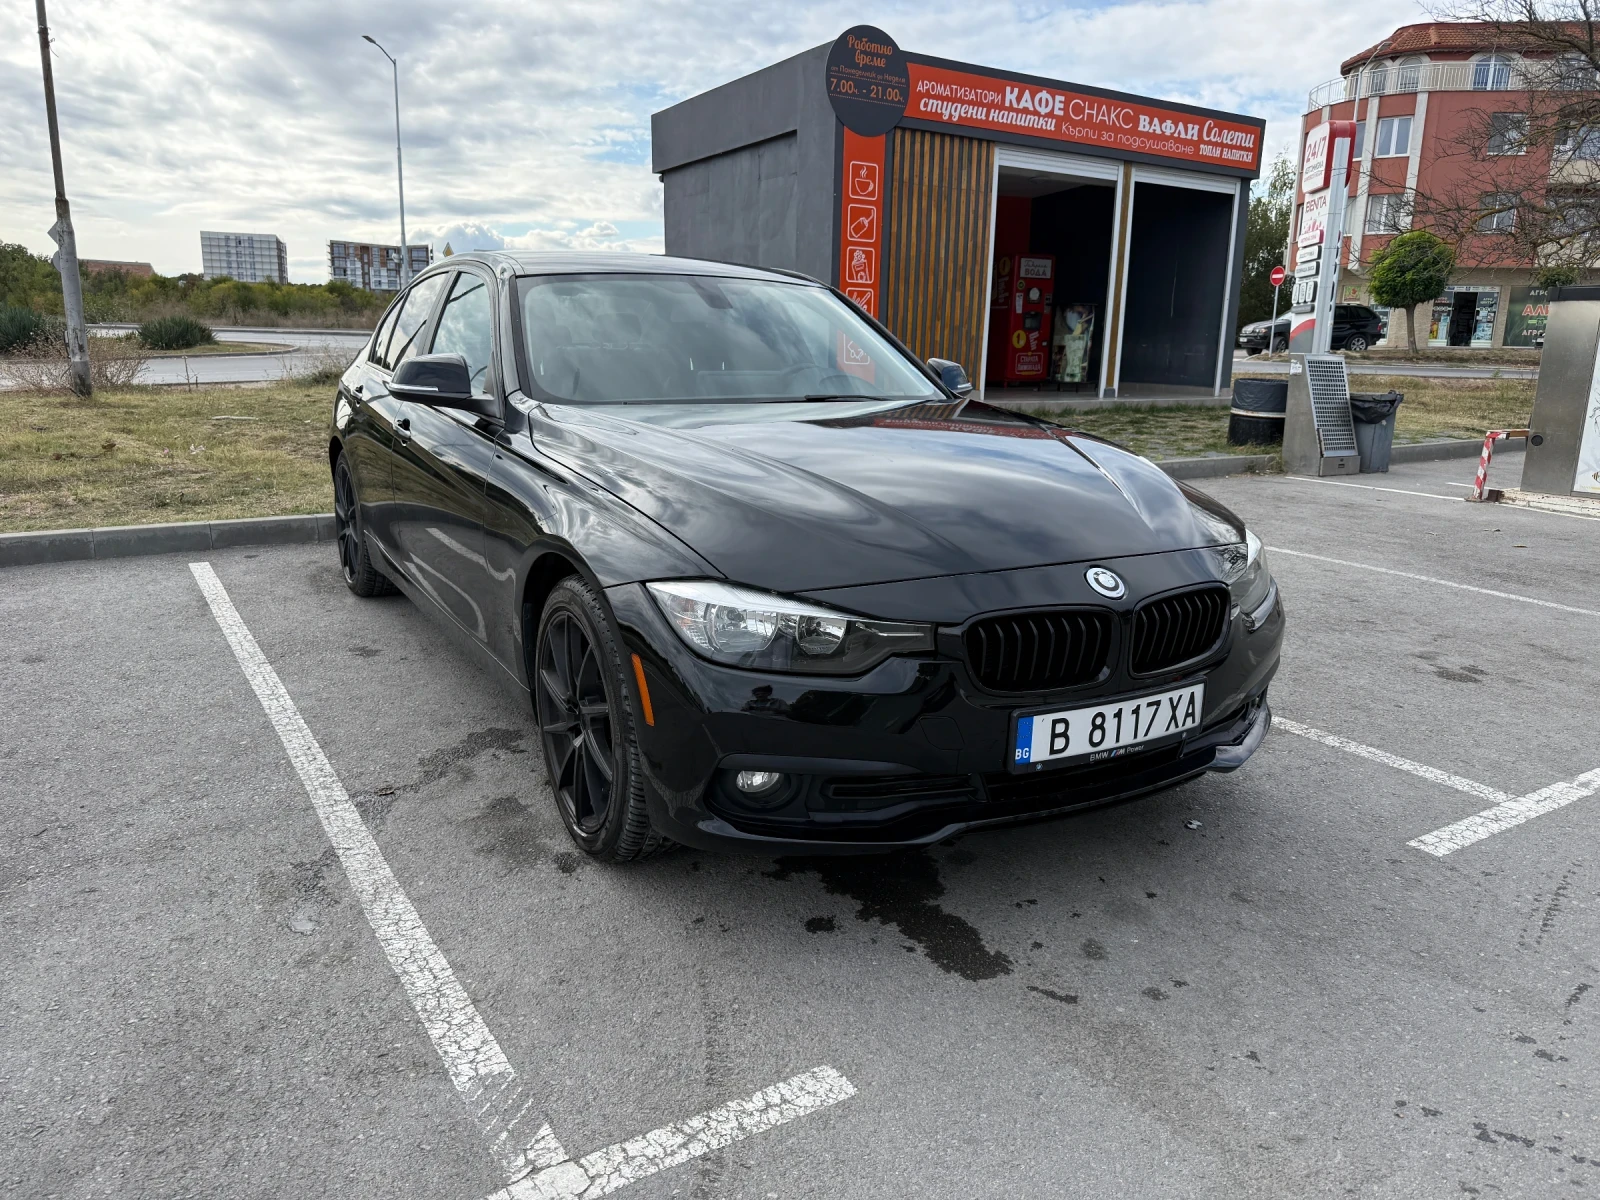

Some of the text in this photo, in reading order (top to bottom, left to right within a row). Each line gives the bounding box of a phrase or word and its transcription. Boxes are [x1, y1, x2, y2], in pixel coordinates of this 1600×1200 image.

[847, 34, 893, 55] Работно
[855, 50, 886, 67] време
[839, 65, 876, 78] Понеделник
[883, 74, 906, 83] Неделя
[916, 79, 1255, 148] АРОМАТИЗАТОРИ КАФЕ СНАКС ВАФЛИ Солети
[919, 97, 1056, 131] студени напитки
[1061, 122, 1195, 155] Кърпи за подсушаване
[1199, 144, 1253, 162] ТОПЛИ НАПИТКИ
[1306, 136, 1327, 163] 24/7
[1024, 268, 1047, 276] ВОДА
[1048, 691, 1197, 756] B 8117 XA
[1015, 748, 1030, 760] BG
[1089, 751, 1109, 762] BMW
[1126, 744, 1145, 754] Power
